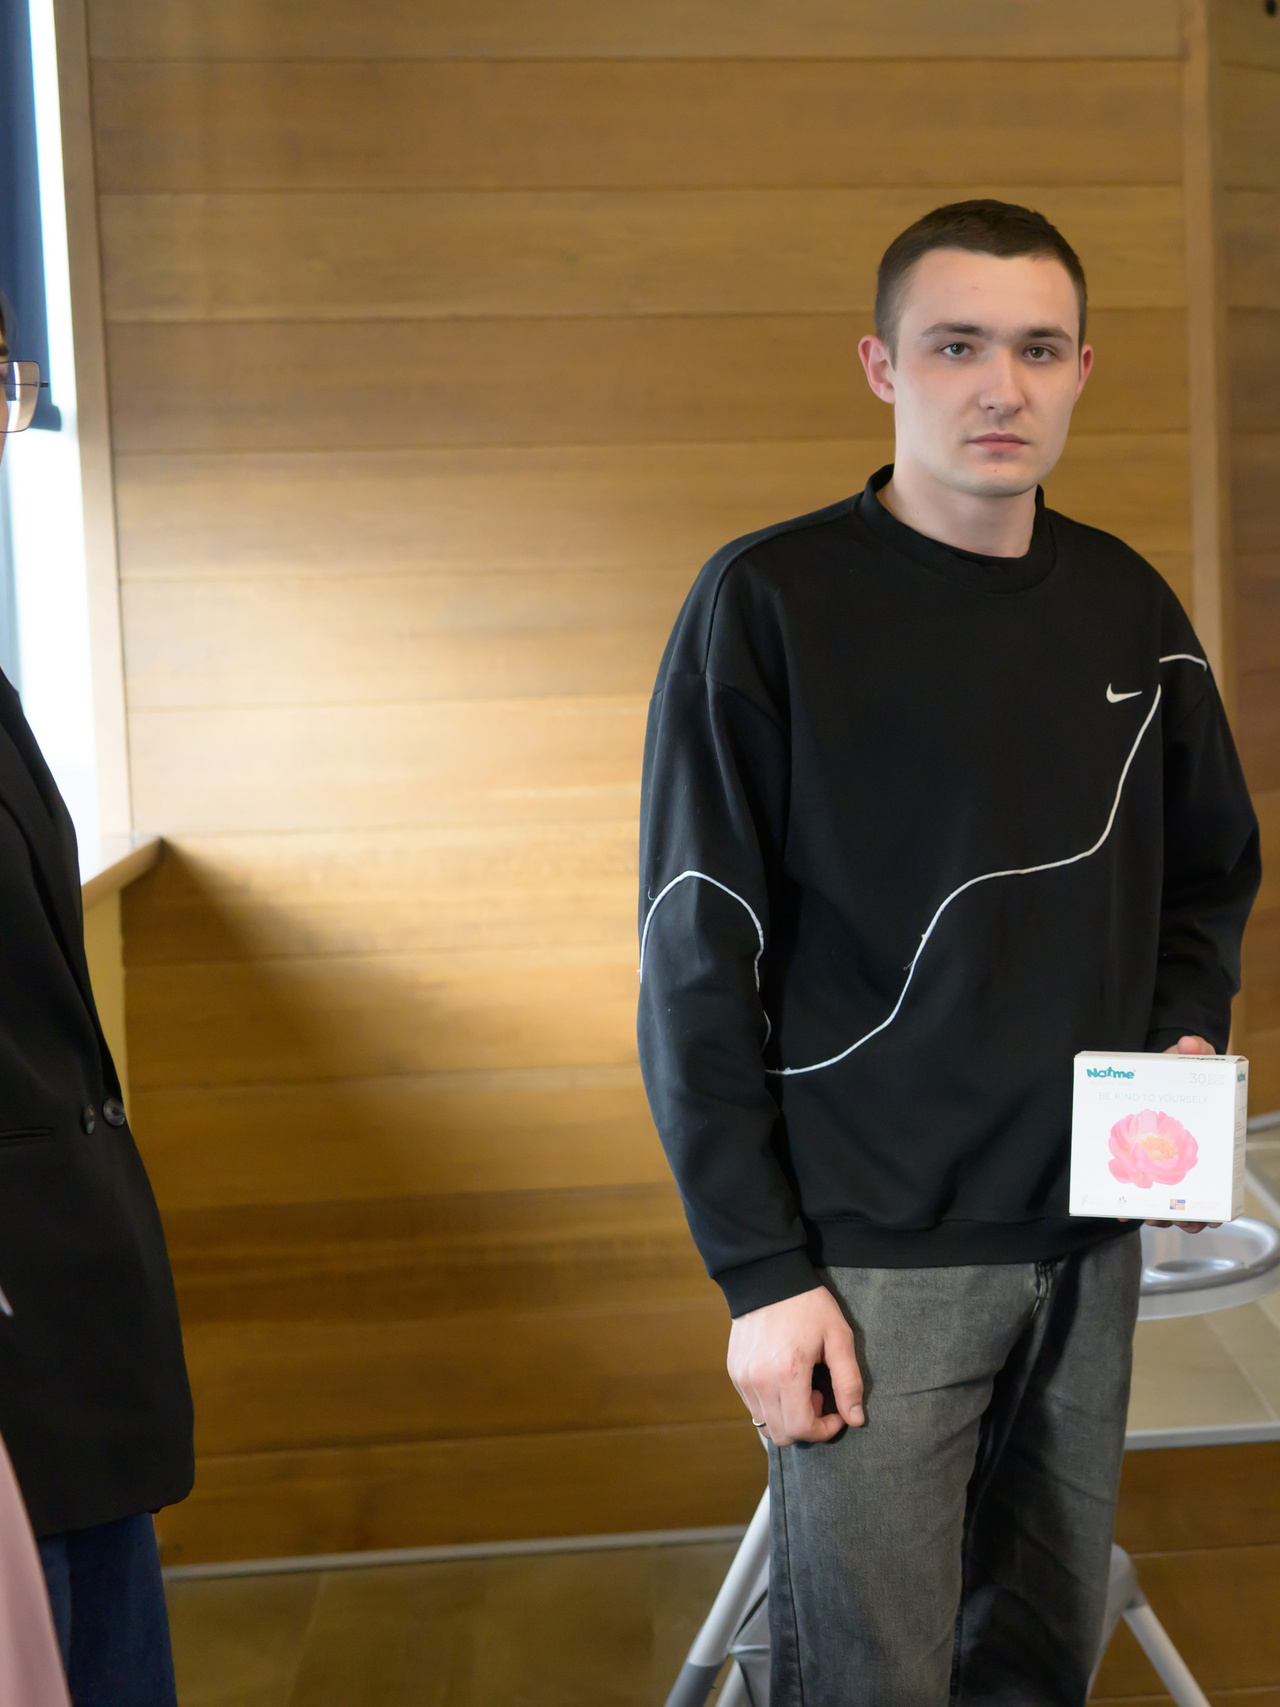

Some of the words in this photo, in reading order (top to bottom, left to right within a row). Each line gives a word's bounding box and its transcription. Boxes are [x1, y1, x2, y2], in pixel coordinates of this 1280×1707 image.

[1189, 1072, 1206, 1084] 30
[1098, 1092, 1111, 1100] BE
[1114, 1092, 1140, 1102] KIND
[1143, 1093, 1156, 1102] TO
[1158, 1094, 1210, 1104] YOURSELF
